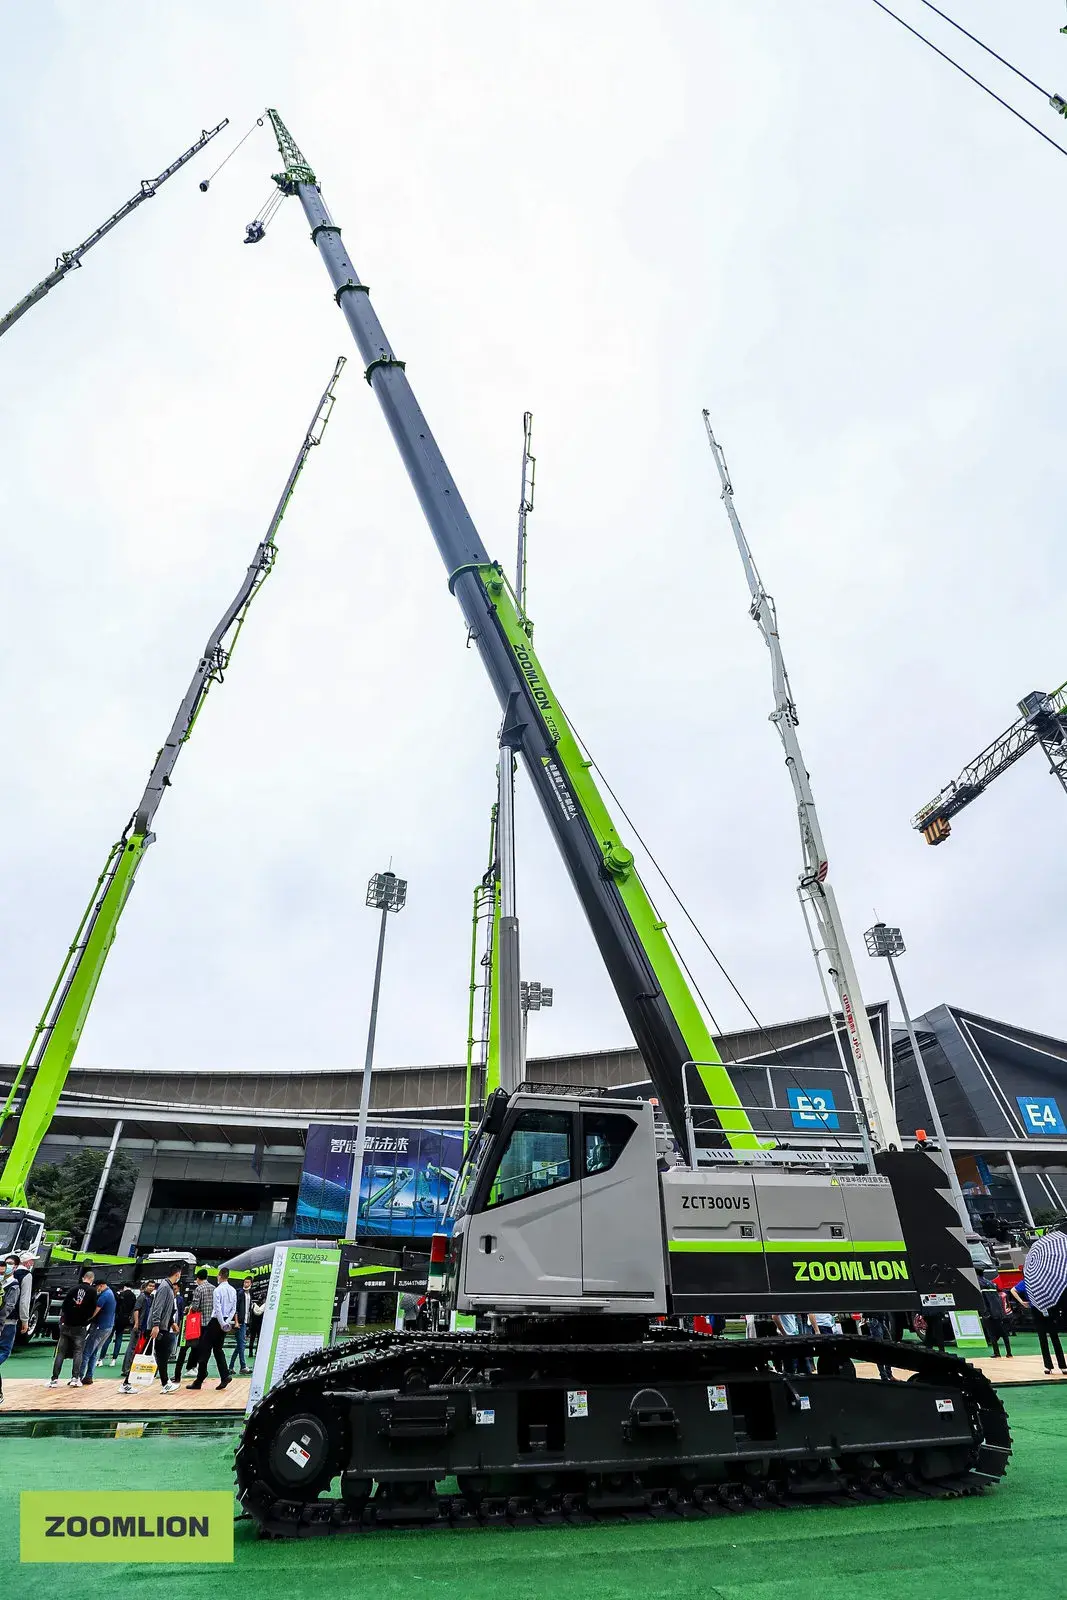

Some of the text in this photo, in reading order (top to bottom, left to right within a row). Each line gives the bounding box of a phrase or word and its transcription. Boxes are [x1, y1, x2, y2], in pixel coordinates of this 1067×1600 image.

[513, 643, 552, 711] ZOOMLION
[797, 1096, 829, 1121] E3
[1025, 1103, 1057, 1127] E4
[681, 1195, 750, 1210] ZCT300V5
[792, 1260, 909, 1282] ZOOMLION
